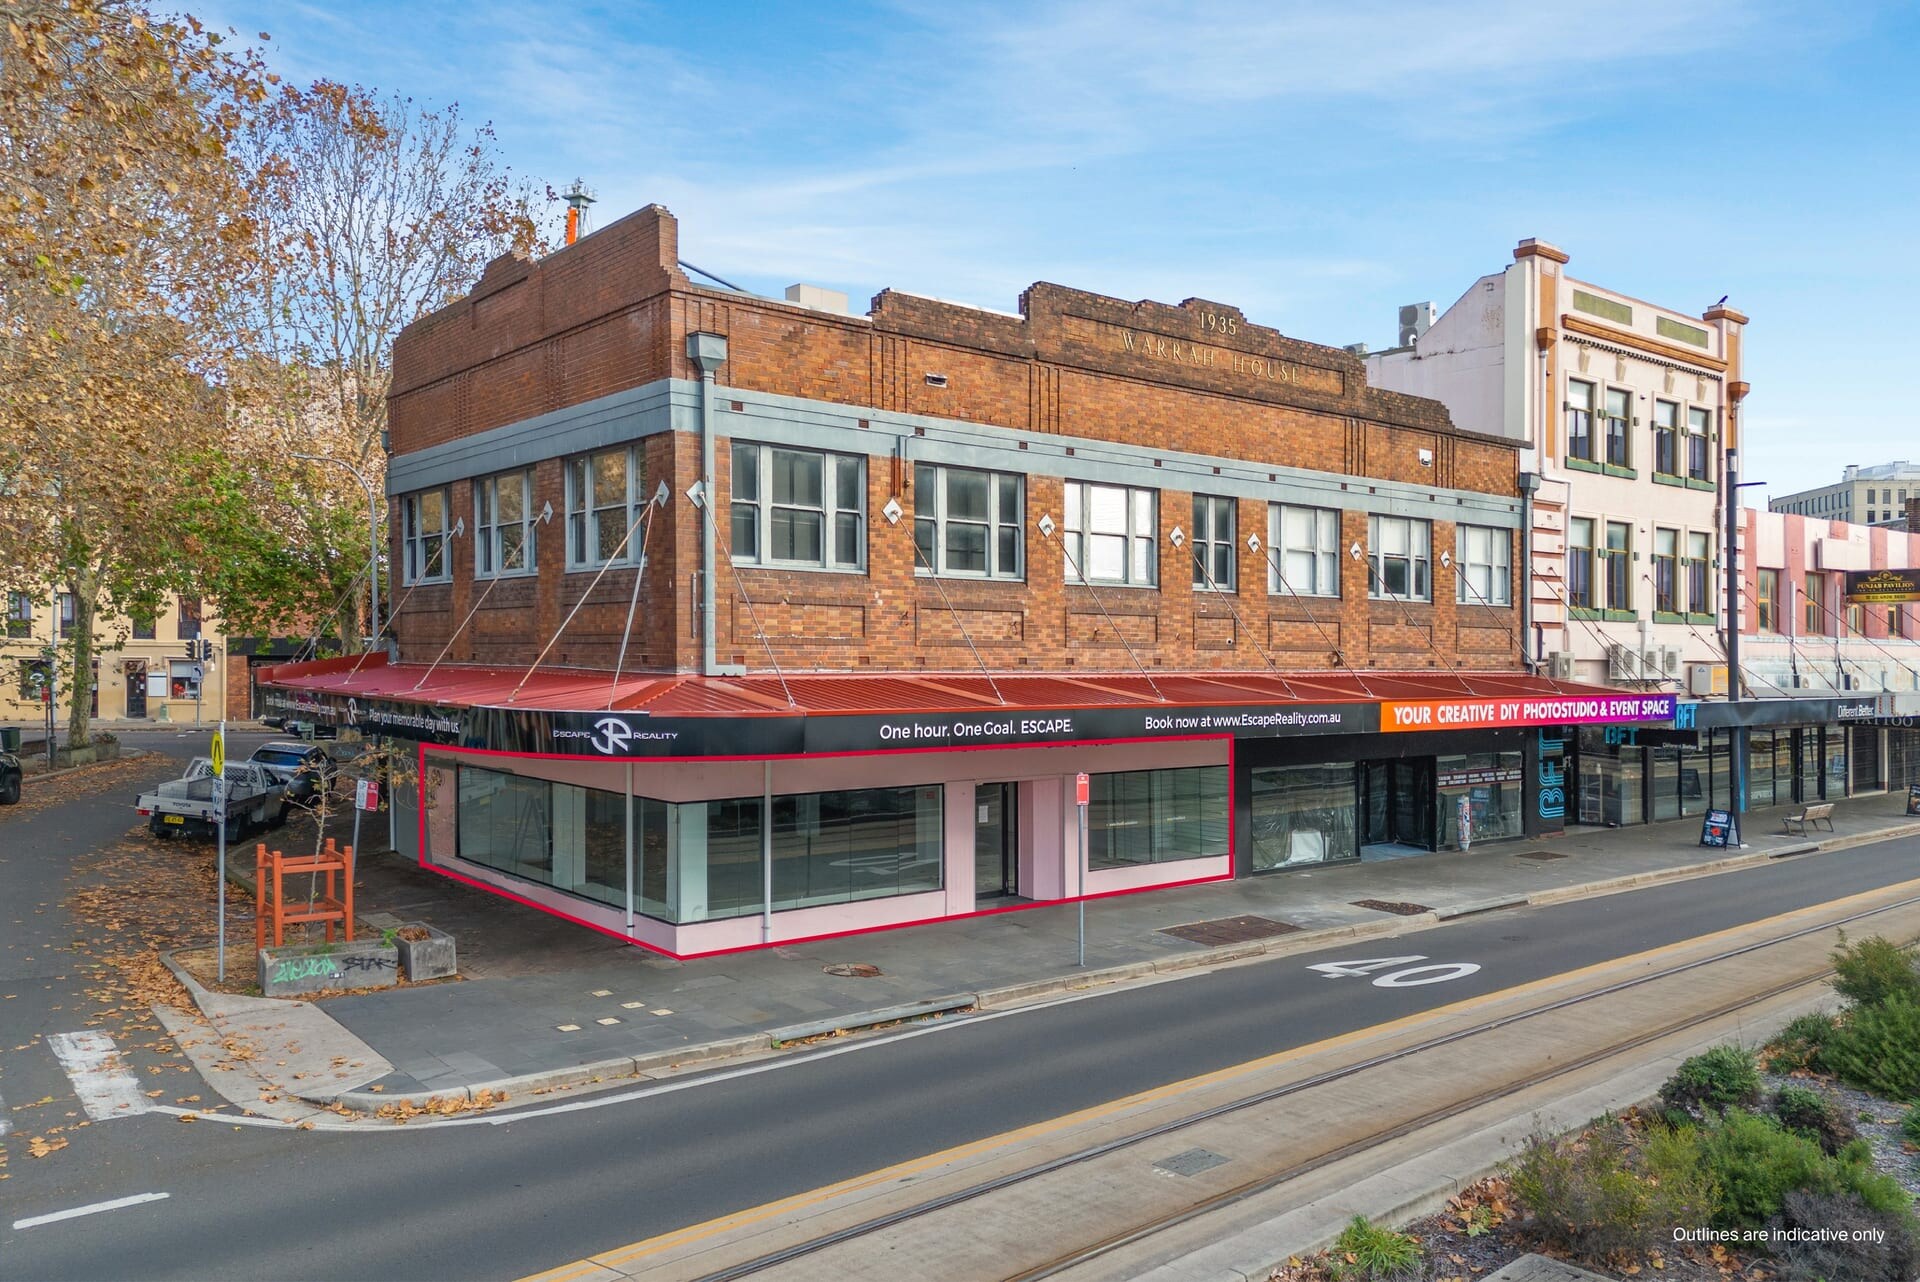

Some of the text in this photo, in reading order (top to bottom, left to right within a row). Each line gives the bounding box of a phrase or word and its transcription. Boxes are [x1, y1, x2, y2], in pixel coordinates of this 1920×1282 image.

[1200, 311, 1237, 336] 1935
[1121, 330, 1300, 384] WARRAH HOUSE
[369, 708, 380, 722] Plan
[380, 713, 392, 726] your
[392, 713, 424, 728] memorable
[424, 714, 436, 733] day
[436, 717, 450, 733] with
[1145, 712, 1341, 729] Book now at www.EscapeReality.com.au
[1393, 700, 1670, 725] YOUR CREATIVE DIY PHOTOSTUDIO & EVENT SPACE
[1676, 704, 1697, 729] BFT
[633, 732, 678, 740] REALITY
[879, 719, 1074, 739] One hour. One Goal. ESCAPE.
[1605, 726, 1639, 746] BFT
[1305, 955, 1482, 987] 40
